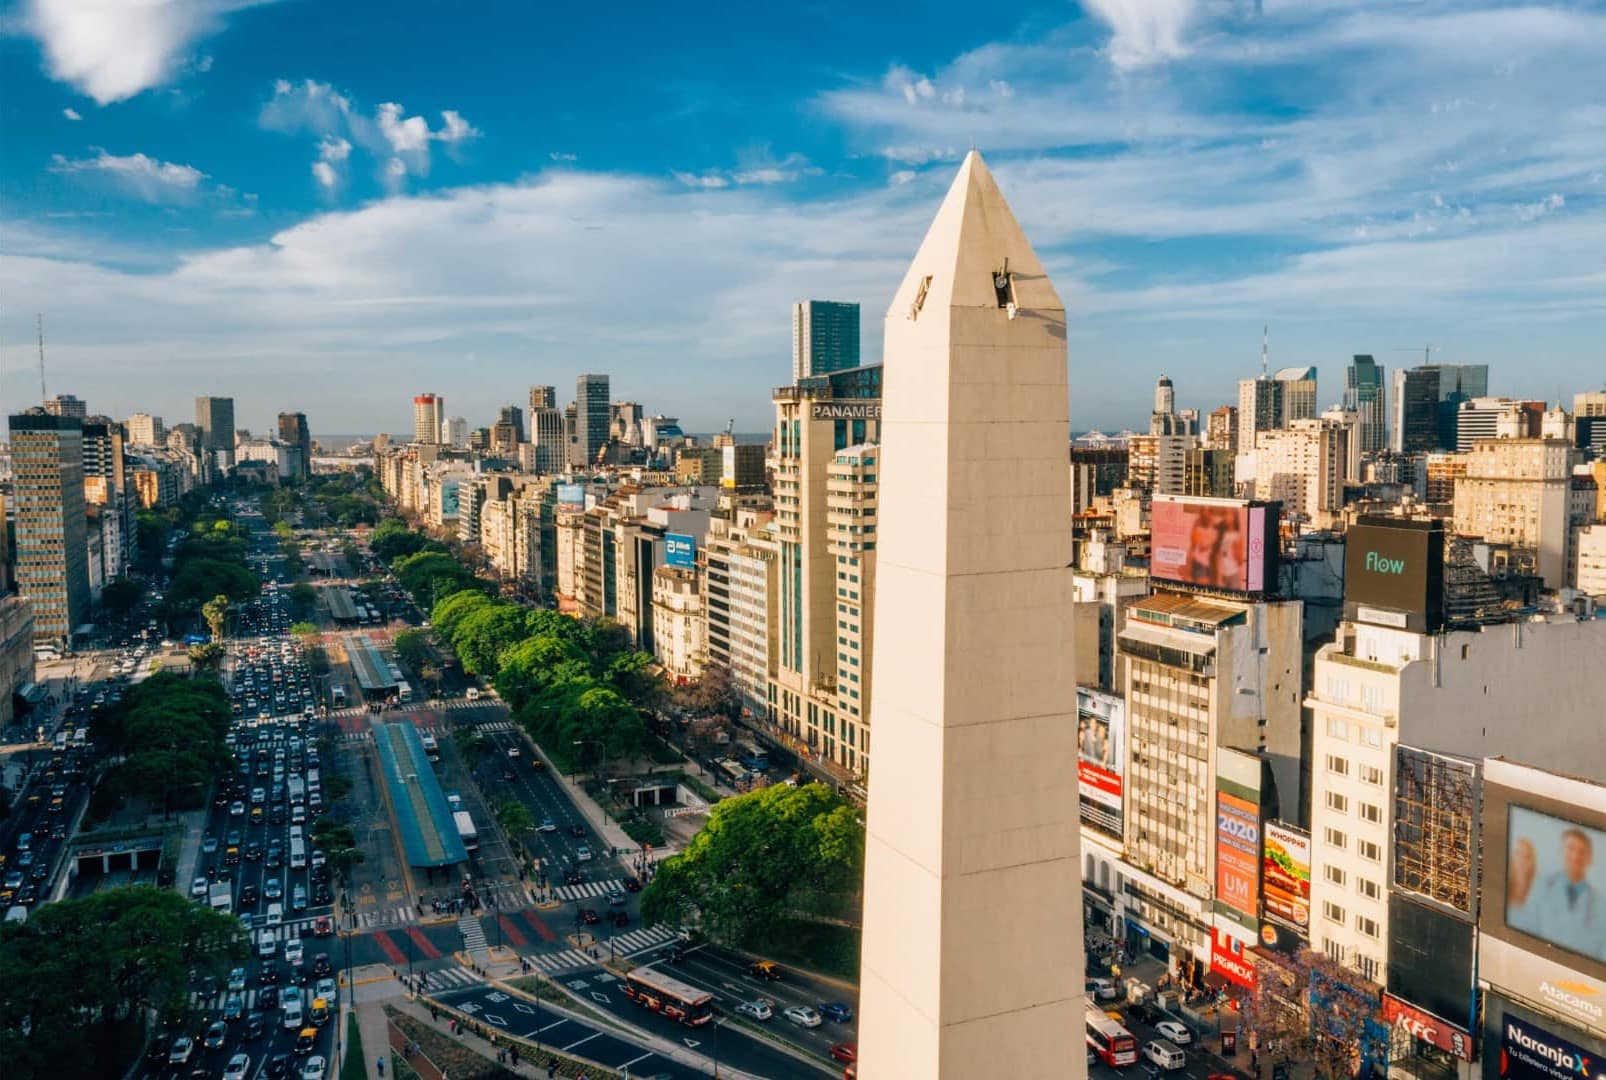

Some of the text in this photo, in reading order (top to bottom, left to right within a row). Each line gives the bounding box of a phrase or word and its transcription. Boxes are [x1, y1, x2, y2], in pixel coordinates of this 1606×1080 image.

[1366, 551, 1405, 575] flow
[1218, 813, 1257, 843] 2020
[1224, 871, 1249, 897] UM
[1539, 981, 1603, 1017] Atacama
[1396, 1011, 1437, 1045] KFC
[1508, 1046, 1518, 1057] Tu
